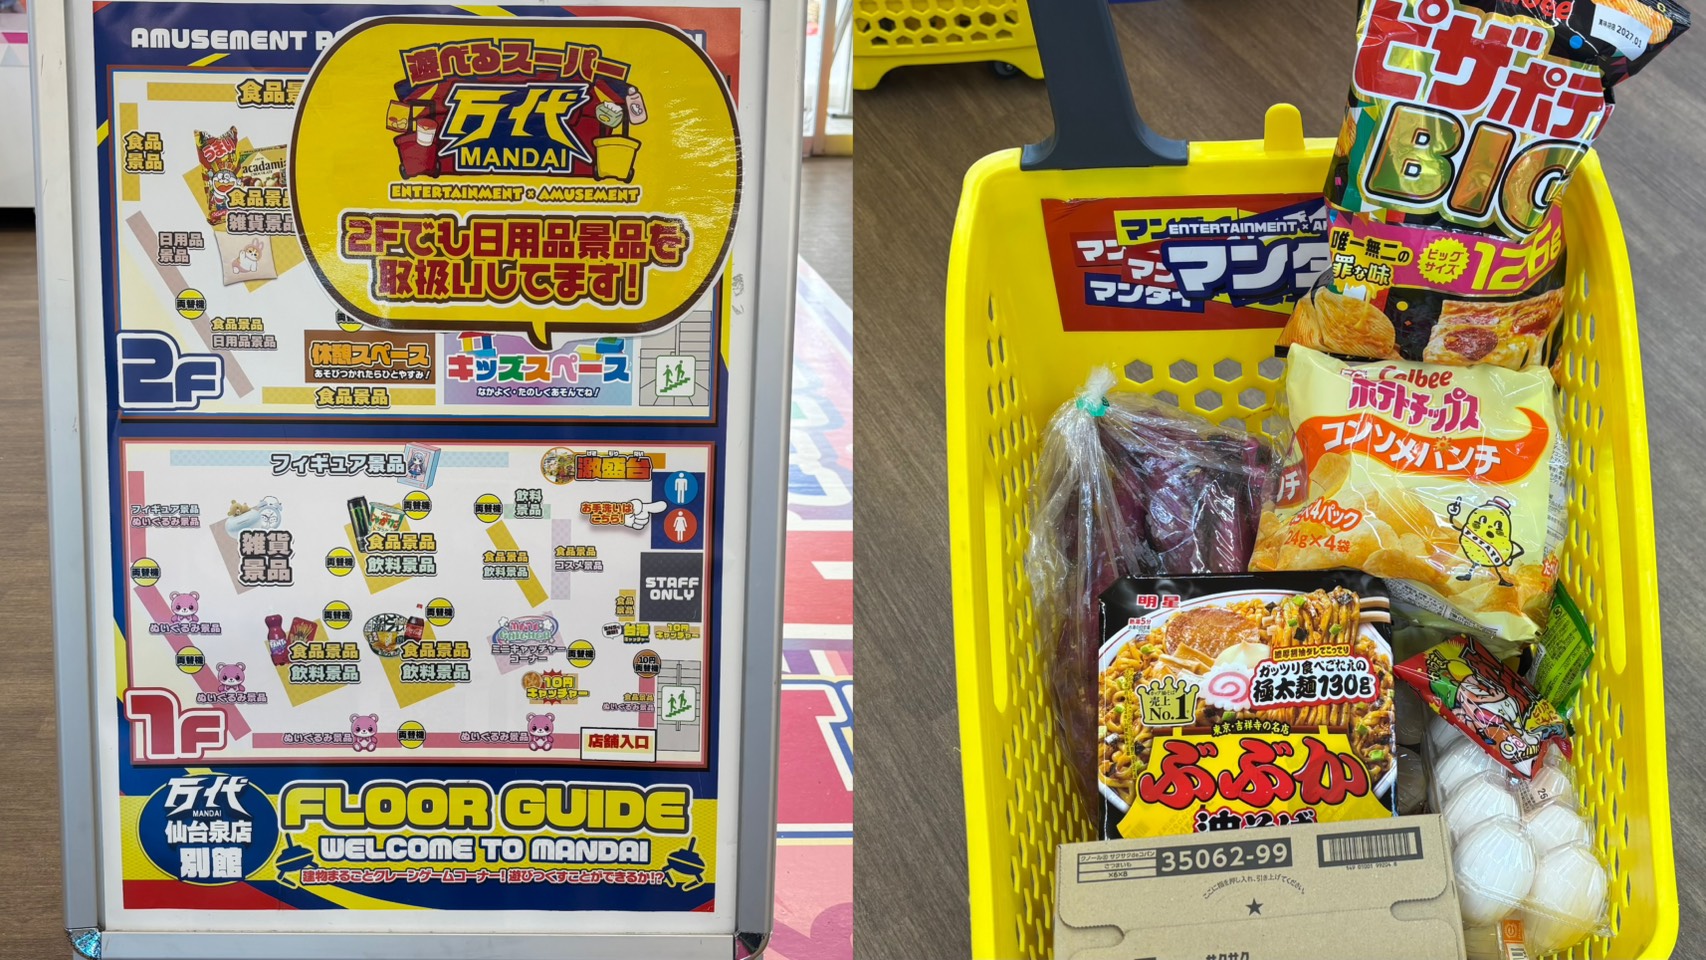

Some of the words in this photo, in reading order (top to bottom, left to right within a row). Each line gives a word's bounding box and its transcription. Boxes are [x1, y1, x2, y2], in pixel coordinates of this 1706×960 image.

[131, 28, 307, 50] AMUSEMENT
[1616, 25, 1642, 48] 2027.01
[405, 41, 628, 84] 遊べるスーパー
[443, 87, 590, 148] 万代
[124, 132, 163, 151] 食品
[125, 152, 164, 173] 景品
[461, 147, 569, 168] MANDAI
[391, 186, 522, 201] ENTERTAINMENT
[538, 187, 640, 203] AMUSEMENT
[1168, 222, 1297, 236] ENTERTAINMENT
[159, 232, 204, 248] 日用品
[345, 218, 688, 262] 2Fでも日用品景品を
[1331, 231, 1410, 264] 唯一無二の
[158, 248, 190, 264] 景品
[1428, 248, 1465, 262] ビッグ
[1332, 254, 1393, 286] 罪な味
[1425, 261, 1458, 275] サイズ
[377, 260, 638, 301] 取扱いしてます!
[176, 299, 206, 310] 両替機
[211, 318, 264, 332] 食品景品
[212, 335, 277, 349] 日用品景品
[312, 342, 429, 366] 休憩スペース
[119, 334, 221, 407] 2F
[315, 369, 430, 380] あそびつかれたらひとやすみ!
[448, 354, 630, 383] キッズスペース
[316, 387, 389, 407] 食品景品
[477, 387, 599, 398] なかよく・たのしくあそんでね!
[1321, 419, 1500, 476] コンソメパンチ
[271, 453, 406, 475] フィギュア景品
[515, 489, 543, 502] 飲料
[131, 504, 199, 515] フィギュア景品
[403, 501, 431, 510] 両替機
[475, 504, 502, 513] 両替機
[515, 503, 543, 517] 景品
[581, 502, 633, 514] お手洗いは
[131, 516, 200, 527] ぬいぐるみ景品
[591, 514, 625, 525] こちら!
[241, 532, 292, 555] 雑貨
[366, 533, 436, 551] 食品景品
[1465, 530, 1501, 563] POTATO
[483, 551, 529, 563] 食品景品
[555, 546, 597, 557] 食品景品
[241, 557, 292, 582] 景品
[326, 557, 355, 567] 両替機
[366, 556, 436, 574] 飲料景品
[555, 561, 603, 571] コスメ景品
[131, 568, 160, 578] 両替機
[483, 566, 529, 578] 飲料景品
[646, 577, 699, 588] STAFF
[650, 589, 695, 600] ONLY
[1137, 595, 1180, 608] 明星
[323, 611, 352, 620] 両替機
[426, 608, 454, 617] 両替機
[150, 623, 221, 633] ぬいぐるみ景品
[290, 642, 360, 660] 食品景品
[401, 642, 470, 659] 食品景品
[492, 644, 566, 654] ミニキャッチャー
[567, 650, 595, 659] 両替機
[176, 656, 205, 665] 両替機
[510, 654, 548, 664] コーナー
[638, 656, 656, 664] 10円
[290, 665, 360, 683] 飲料景品
[401, 664, 470, 682] 飲料景品
[1259, 660, 1366, 677] ガッツリ食べごたえの
[544, 677, 574, 688] 10円
[196, 693, 267, 703] ぬいぐるみ景品
[527, 688, 590, 699] キャッチャー
[1149, 696, 1171, 706] 売上
[1149, 694, 1189, 720] No.1
[126, 690, 226, 758] 1F
[1212, 720, 1290, 736] 東京・吉祥寺の名店
[283, 733, 353, 744] ぬいぐるみ景品
[398, 731, 425, 740] 両替機
[460, 732, 529, 742] ぬいぐるみ景品
[588, 734, 649, 749] 店舗入口
[1139, 737, 1369, 810] ぶぶか
[164, 775, 252, 817] 万代
[282, 784, 491, 829] FLOOR
[503, 785, 688, 832] GUIDE
[165, 821, 252, 844] 仙台泉店
[320, 837, 474, 861] WELCOME
[481, 838, 523, 861] TO
[531, 839, 649, 862] MANDAI
[1161, 842, 1288, 872] 35062-99
[180, 847, 243, 878] 別館
